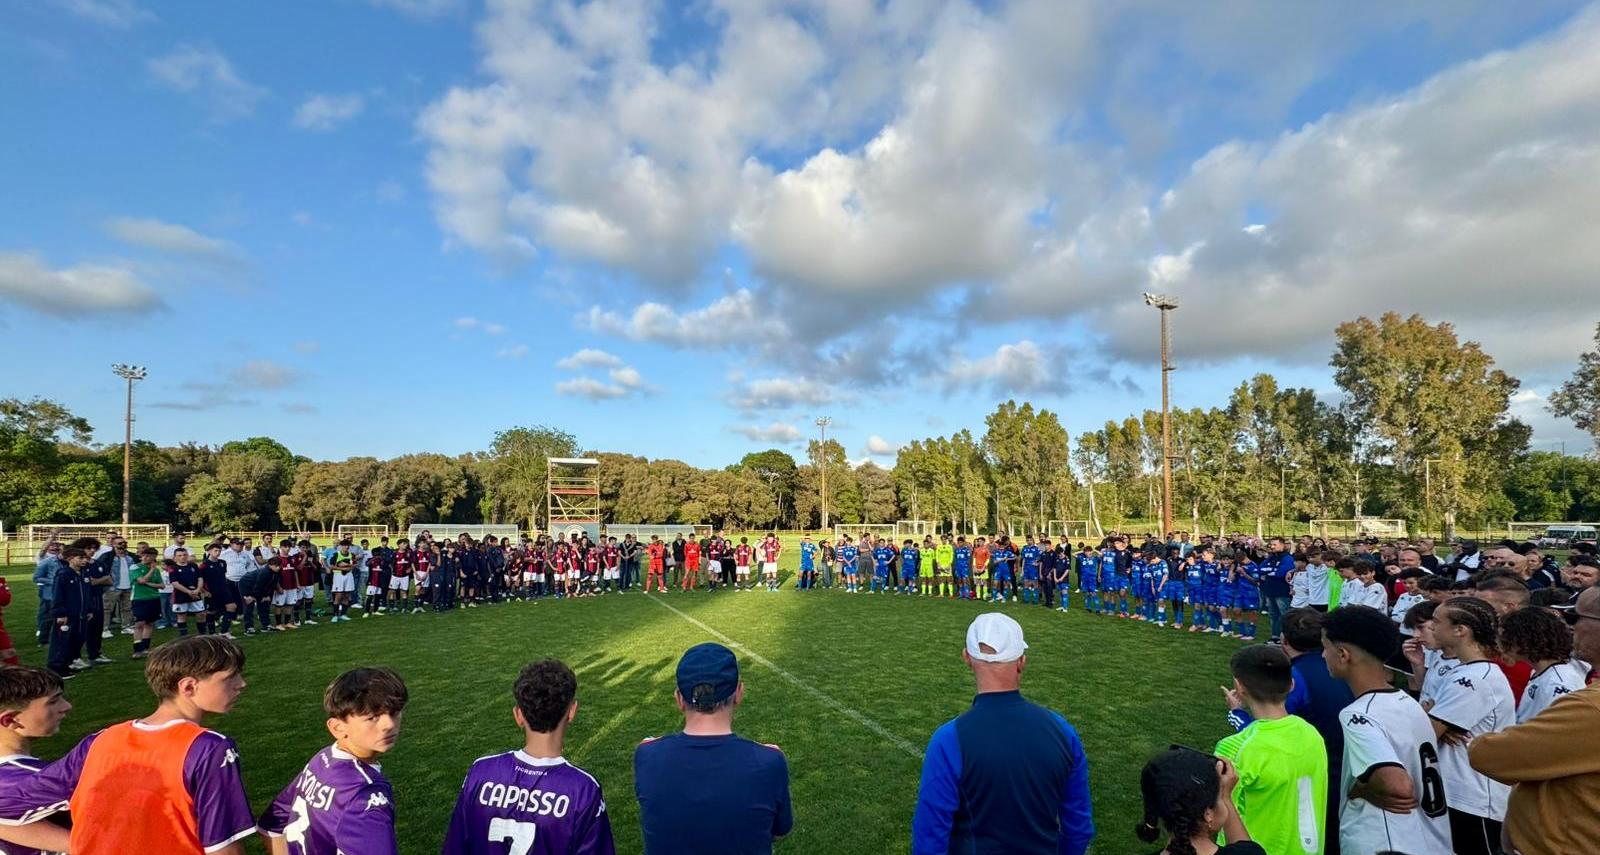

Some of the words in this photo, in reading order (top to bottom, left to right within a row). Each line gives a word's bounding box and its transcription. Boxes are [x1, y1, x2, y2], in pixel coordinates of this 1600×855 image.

[1419, 741, 1448, 818] 6
[479, 781, 570, 818] CAPASSO
[487, 817, 537, 855] 7
